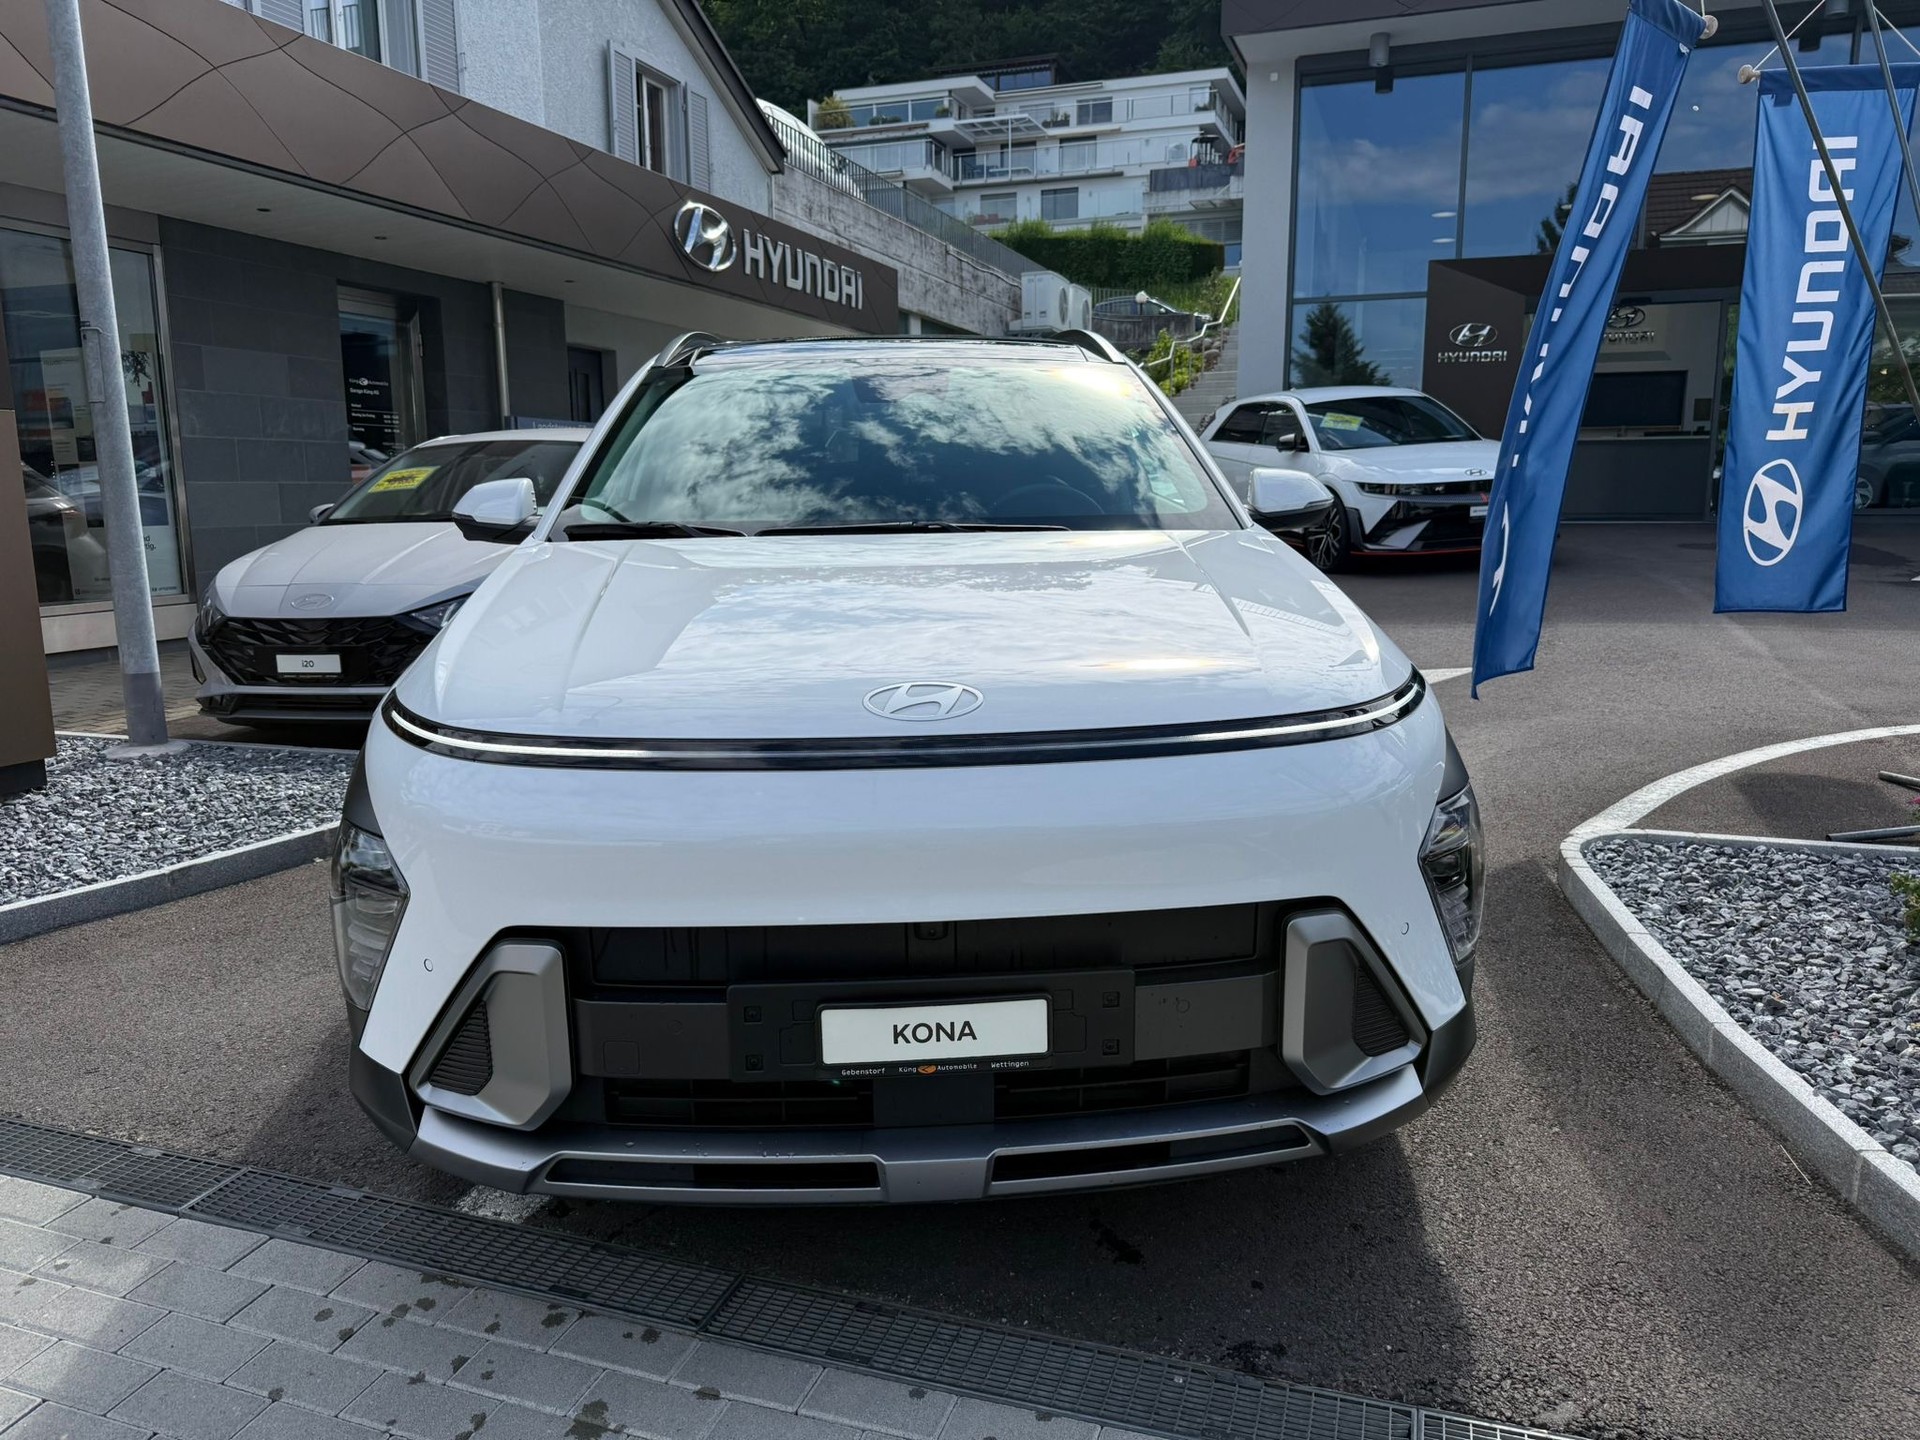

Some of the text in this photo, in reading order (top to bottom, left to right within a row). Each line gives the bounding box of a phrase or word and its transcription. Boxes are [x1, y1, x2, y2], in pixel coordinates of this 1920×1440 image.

[742, 228, 864, 311] HYUNDAI
[1765, 136, 1858, 441] HYUNDAI
[1437, 350, 1508, 363] HYUNDAI
[302, 659, 314, 667] i20
[892, 1020, 978, 1045] KONA
[841, 1060, 1030, 1076] Gebenstorf Küng Automobile Wettingen
